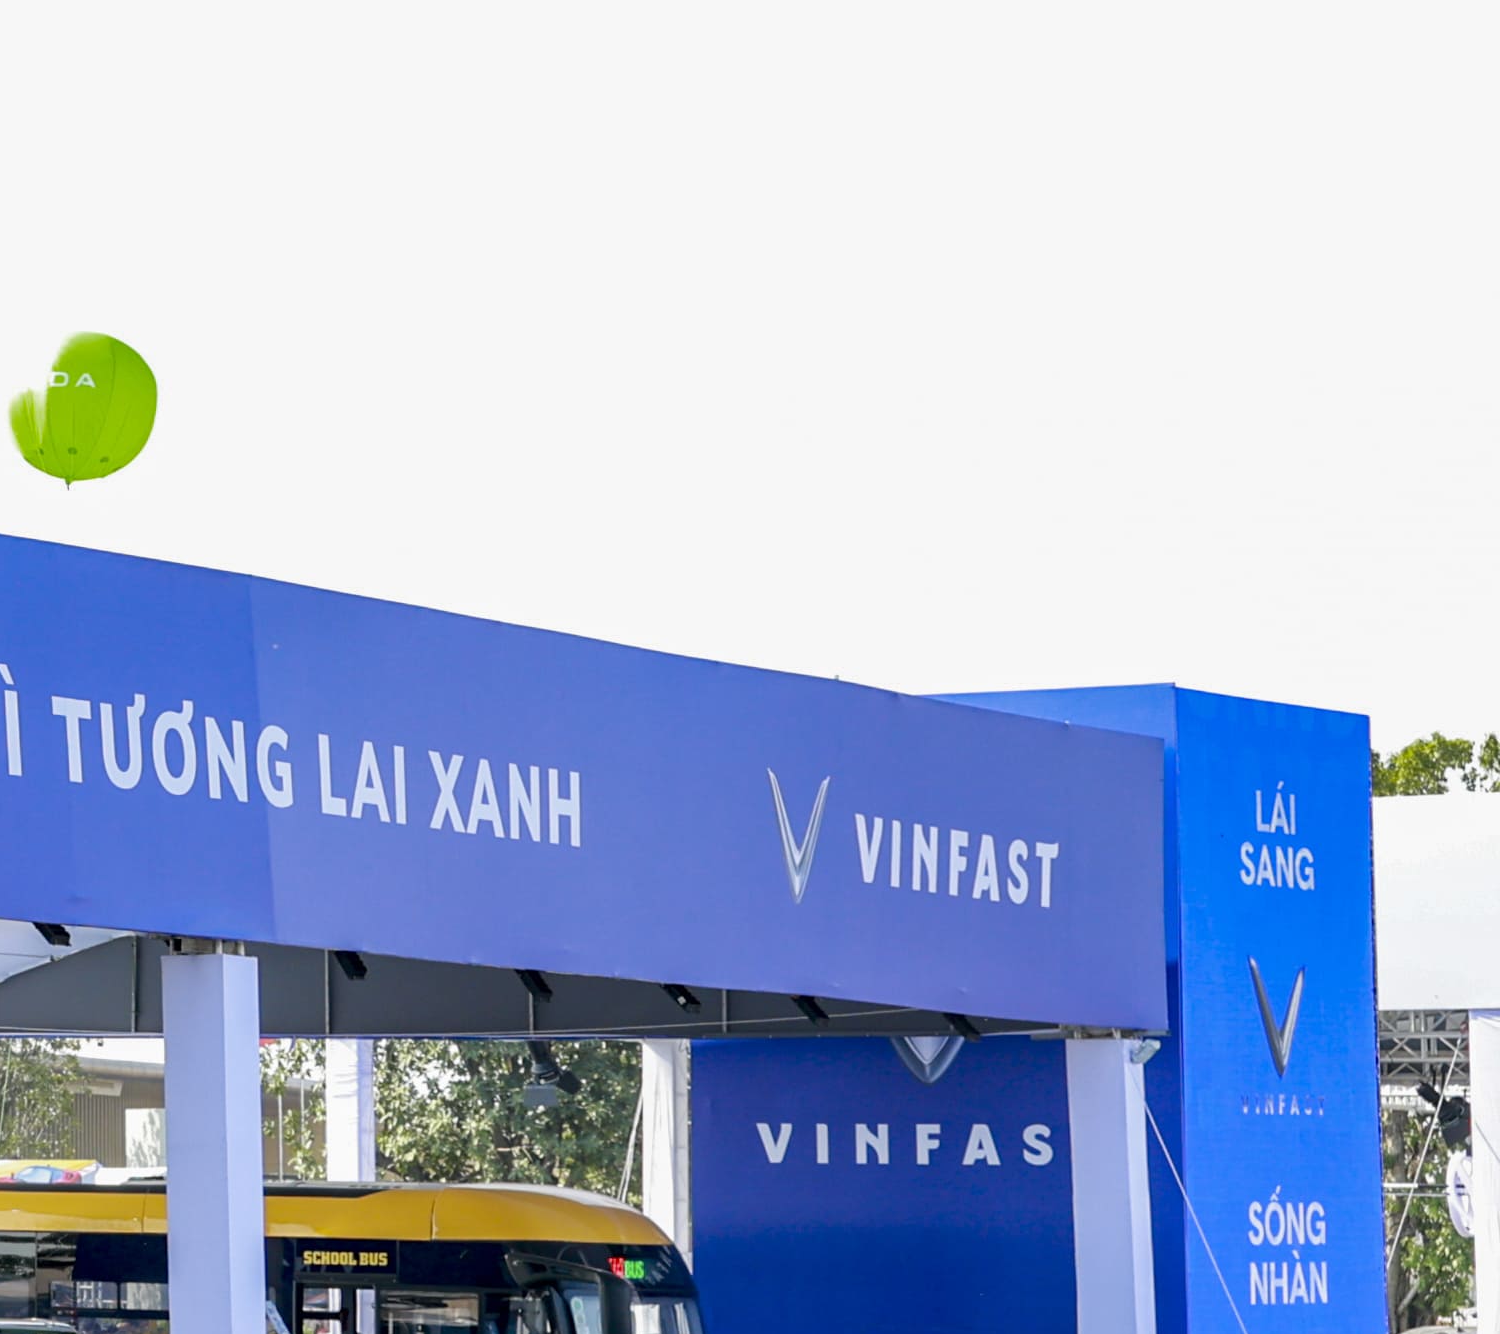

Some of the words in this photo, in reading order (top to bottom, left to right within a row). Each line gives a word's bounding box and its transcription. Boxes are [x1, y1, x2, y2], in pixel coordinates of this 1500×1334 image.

[51, 692, 294, 808] TƯƠNG
[318, 733, 407, 825] LAI
[428, 750, 581, 847] XANH
[1255, 780, 1296, 835] LÁI
[853, 813, 1060, 908] VINFAST
[1240, 841, 1315, 891] SANG
[757, 1123, 1054, 1166] VINFAS
[1248, 1185, 1327, 1246] SỐNG
[303, 1250, 357, 1266] SCHOOL
[359, 1252, 388, 1266] BUS
[1249, 1249, 1329, 1305] NHÀN
